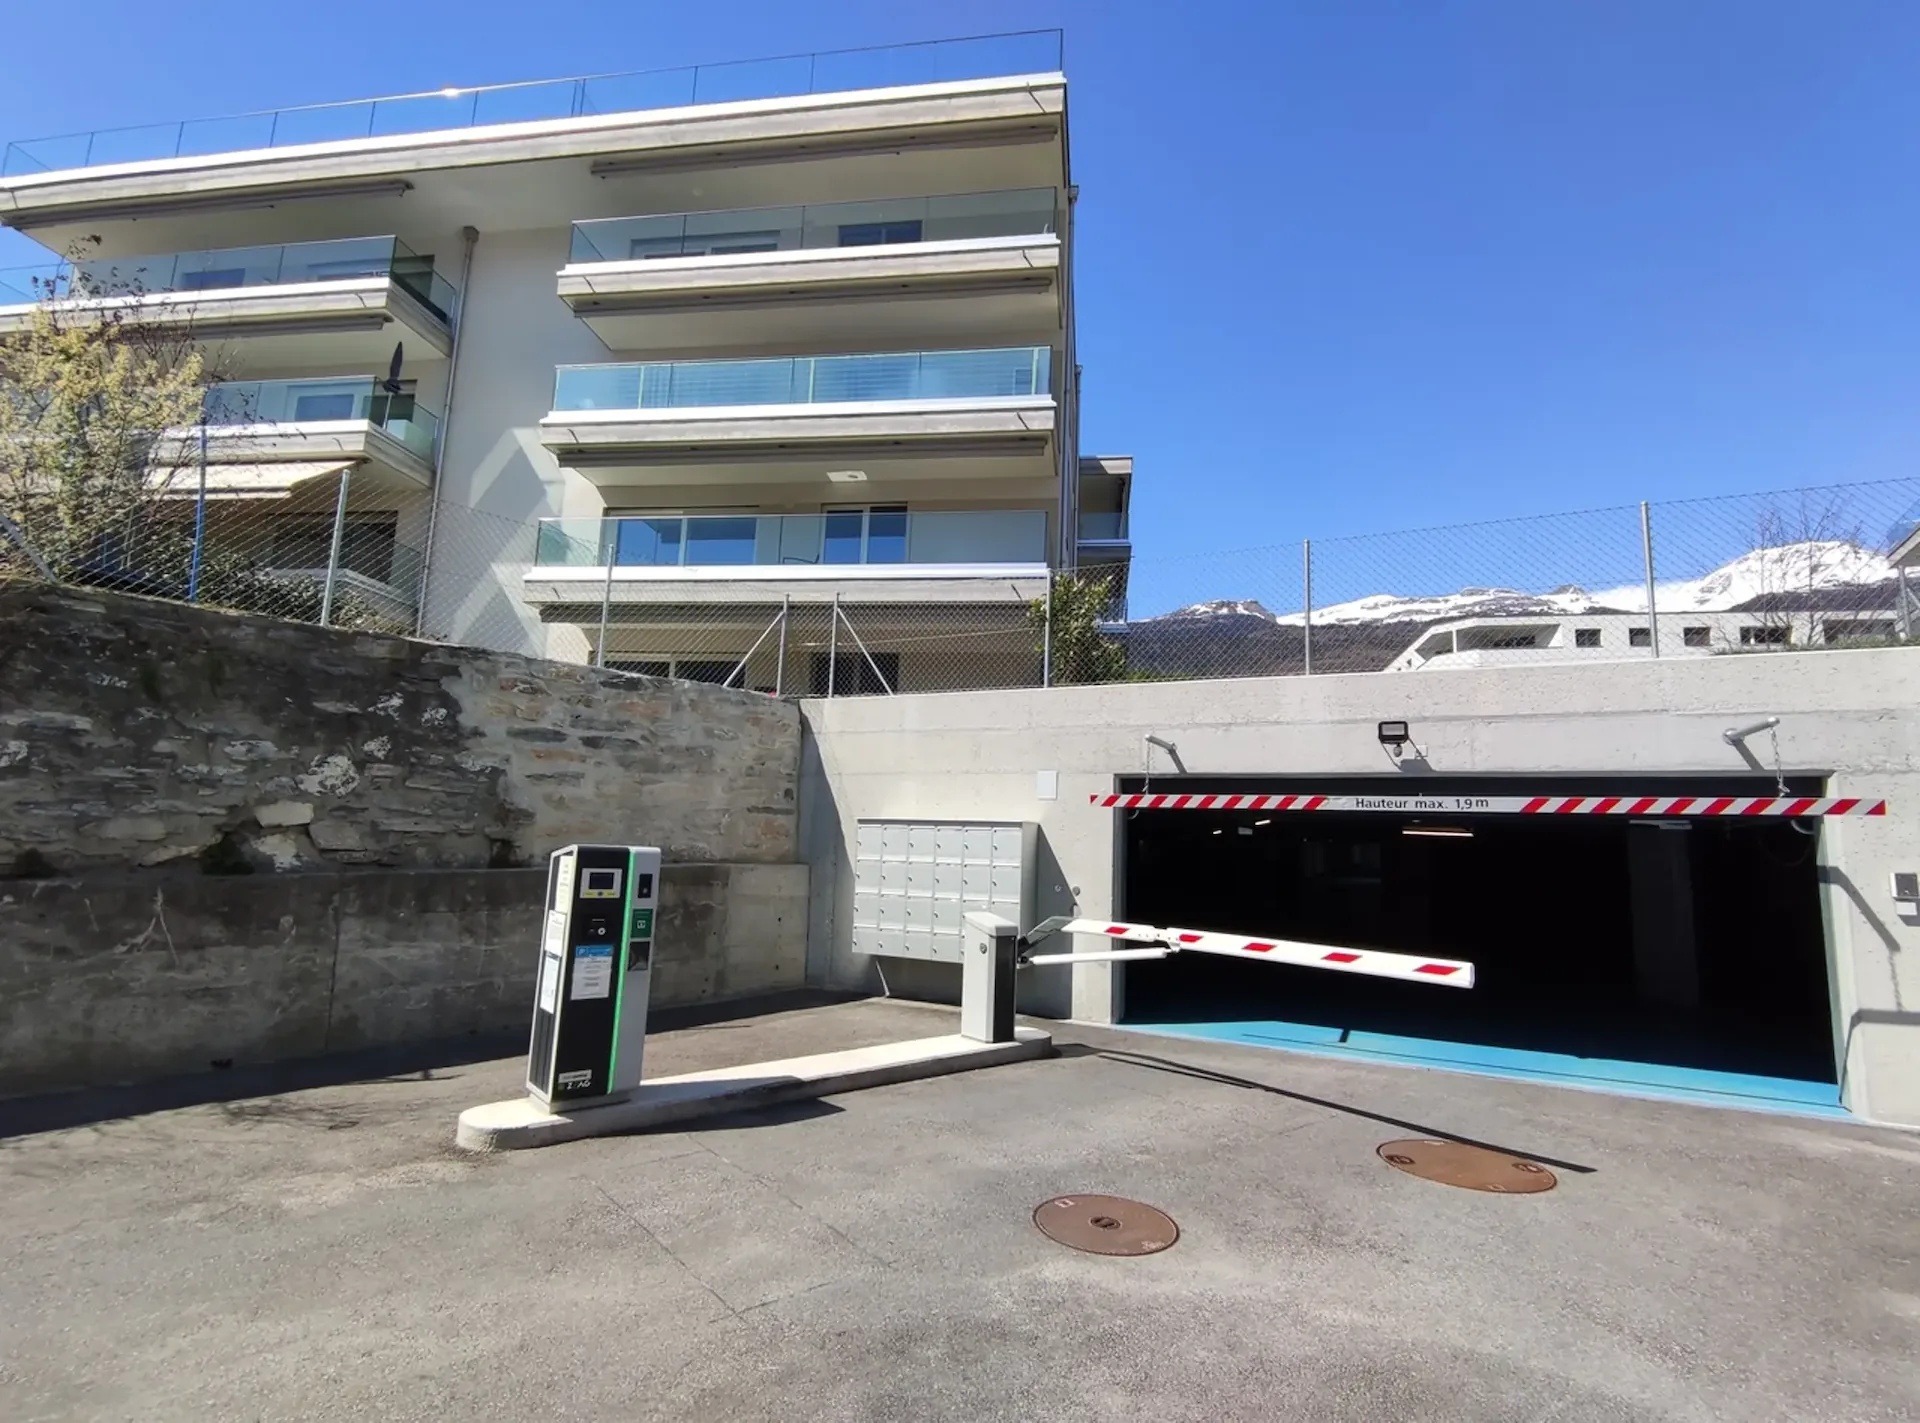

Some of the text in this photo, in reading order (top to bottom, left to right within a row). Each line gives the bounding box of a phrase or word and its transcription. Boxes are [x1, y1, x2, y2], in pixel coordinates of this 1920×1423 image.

[1355, 798, 1408, 809] Hauteur
[1415, 800, 1449, 809] max.
[1455, 798, 1473, 811] 1,9
